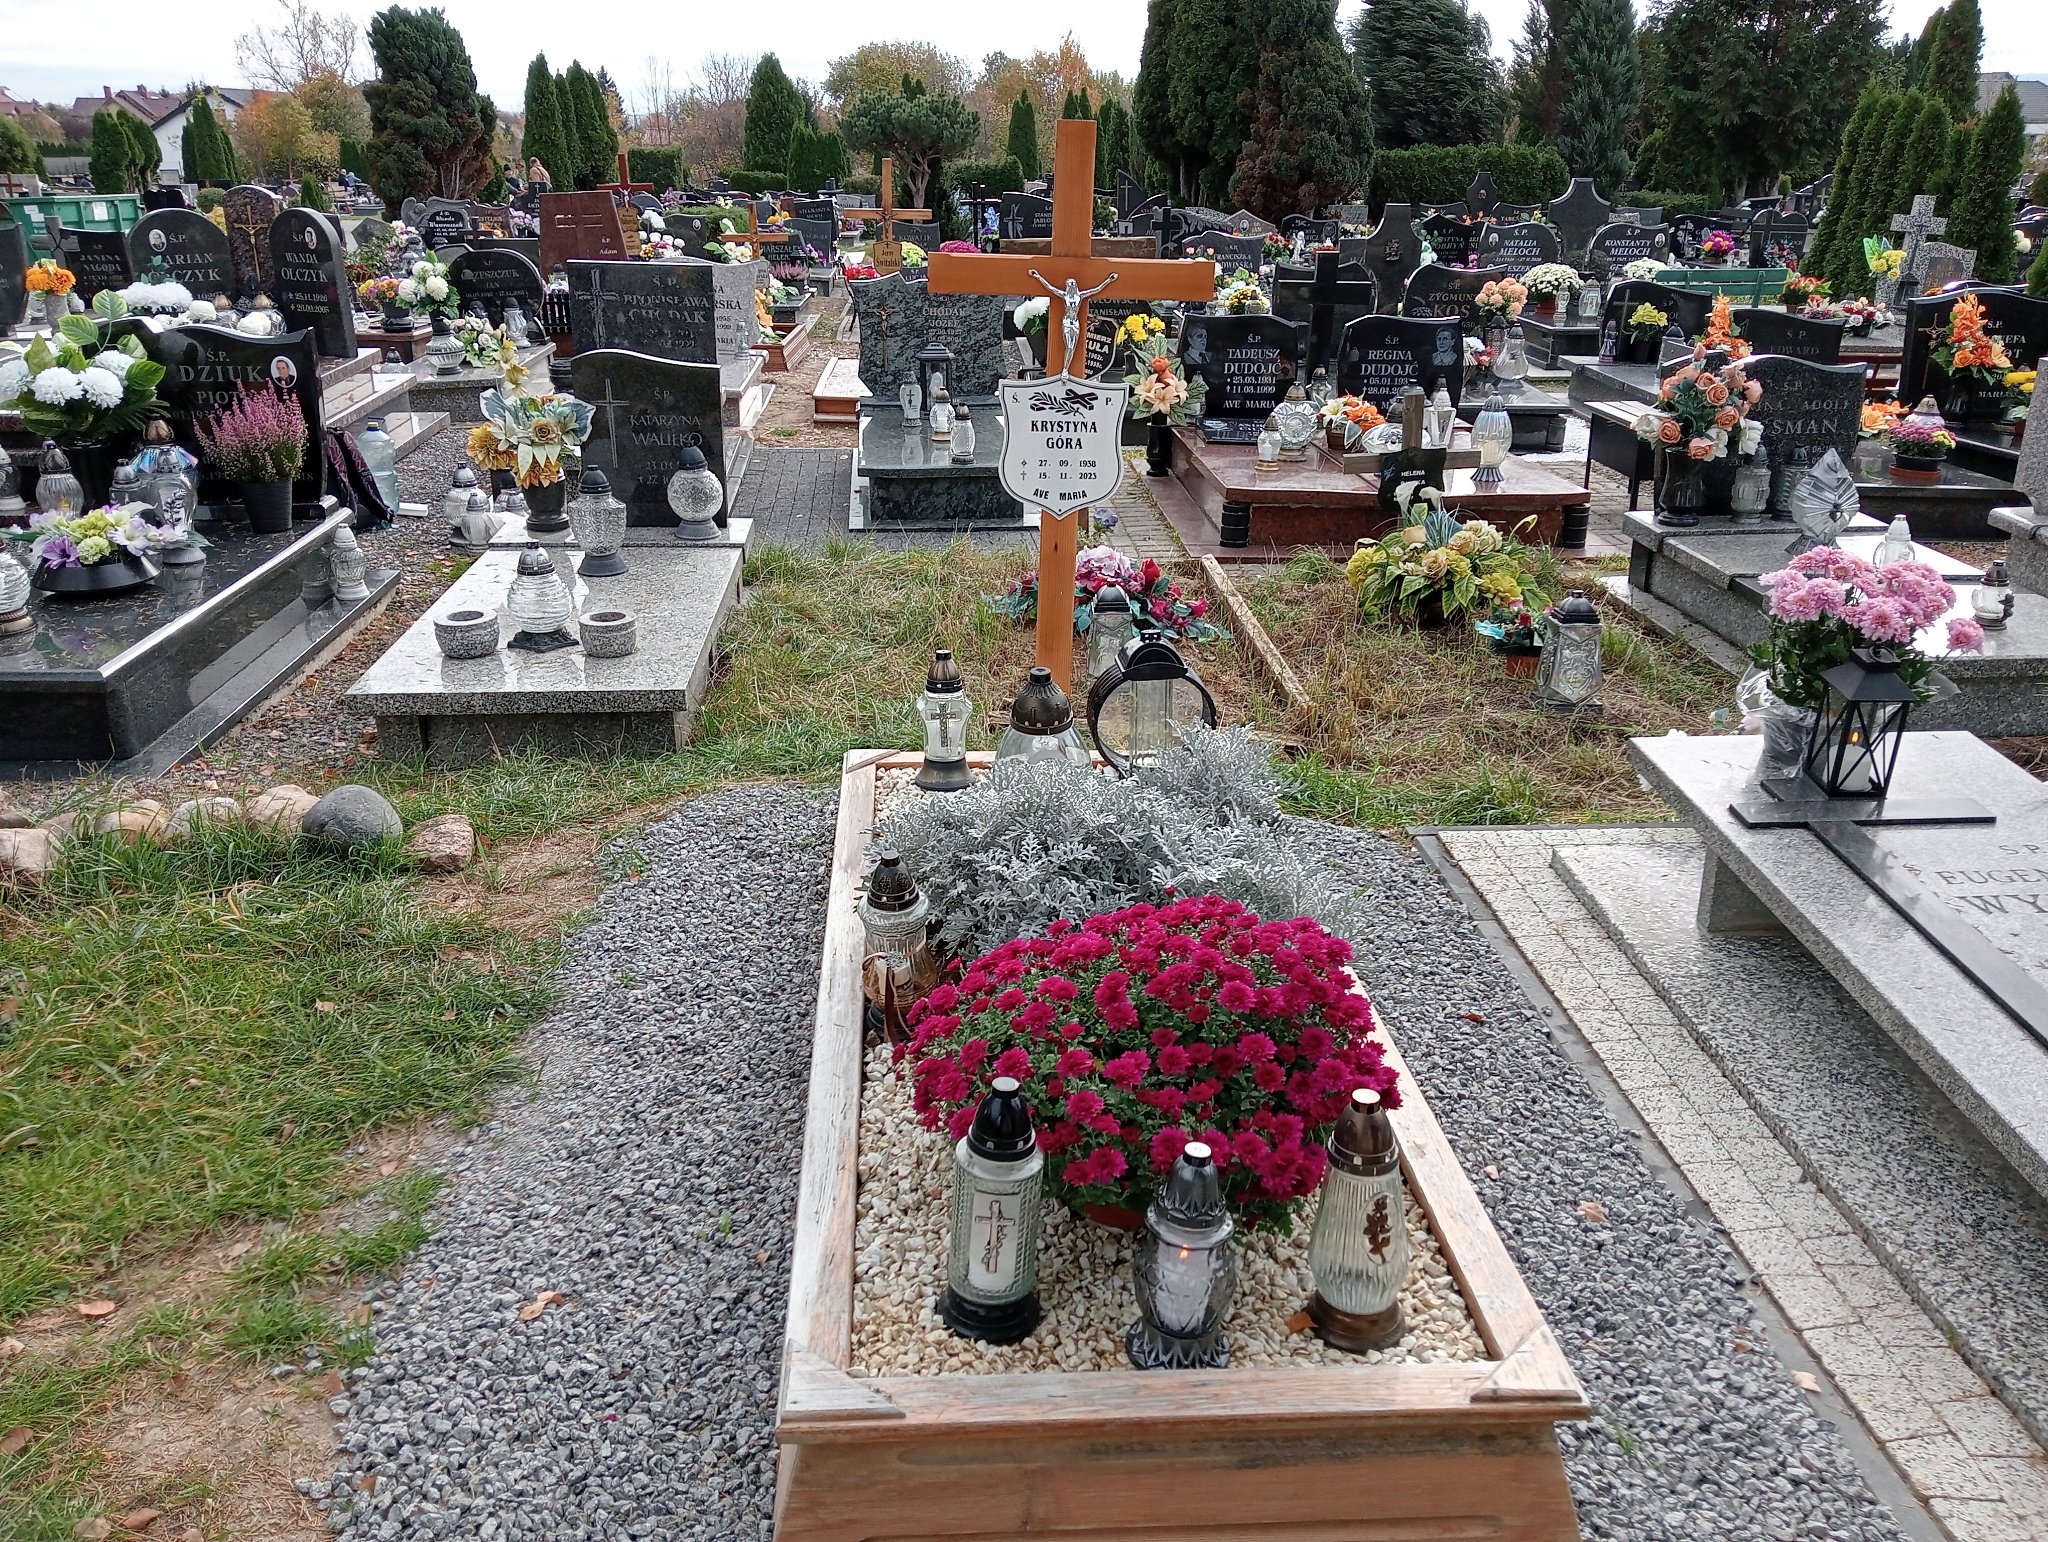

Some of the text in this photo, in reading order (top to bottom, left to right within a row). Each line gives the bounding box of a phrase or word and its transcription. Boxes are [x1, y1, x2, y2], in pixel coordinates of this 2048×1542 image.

[1503, 239, 1537, 247] NATALIA
[1604, 239, 1652, 247] KONSTANTY
[1498, 247, 1542, 256] MELOCH
[1609, 247, 1652, 256] MELOCH
[285, 252, 318, 264] WANDA
[149, 268, 222, 283] OCZYK
[281, 267, 329, 282] OLCZYK
[1428, 292, 1474, 302] ZYGMUN
[1090, 308, 1132, 316] TANISŁAW
[1247, 333, 1262, 343] Ś.P.
[1385, 334, 1400, 345] Ś.P.
[206, 348, 230, 362] Ś.P.
[1227, 348, 1281, 359] TADEUSZ
[1368, 349, 1413, 361] REGINA
[178, 364, 266, 382] DZIUK
[1360, 361, 1419, 376] DUDOJĆ
[1232, 376, 1277, 384] 23.03.1931
[1369, 377, 1409, 386] 05.01.193
[1232, 385, 1276, 394] 11.03.1999
[197, 390, 253, 405] PIOT
[1223, 399, 1276, 409] AVE MARIA
[1030, 420, 1098, 433] KRYSTYNA
[1771, 418, 1838, 435] SMAN
[1046, 435, 1083, 450] GÓRA
[1079, 459, 1097, 468] 1938
[1079, 472, 1097, 480] 2023
[1401, 469, 1426, 477] HELENA
[1033, 488, 1088, 501] AVE MARIA
